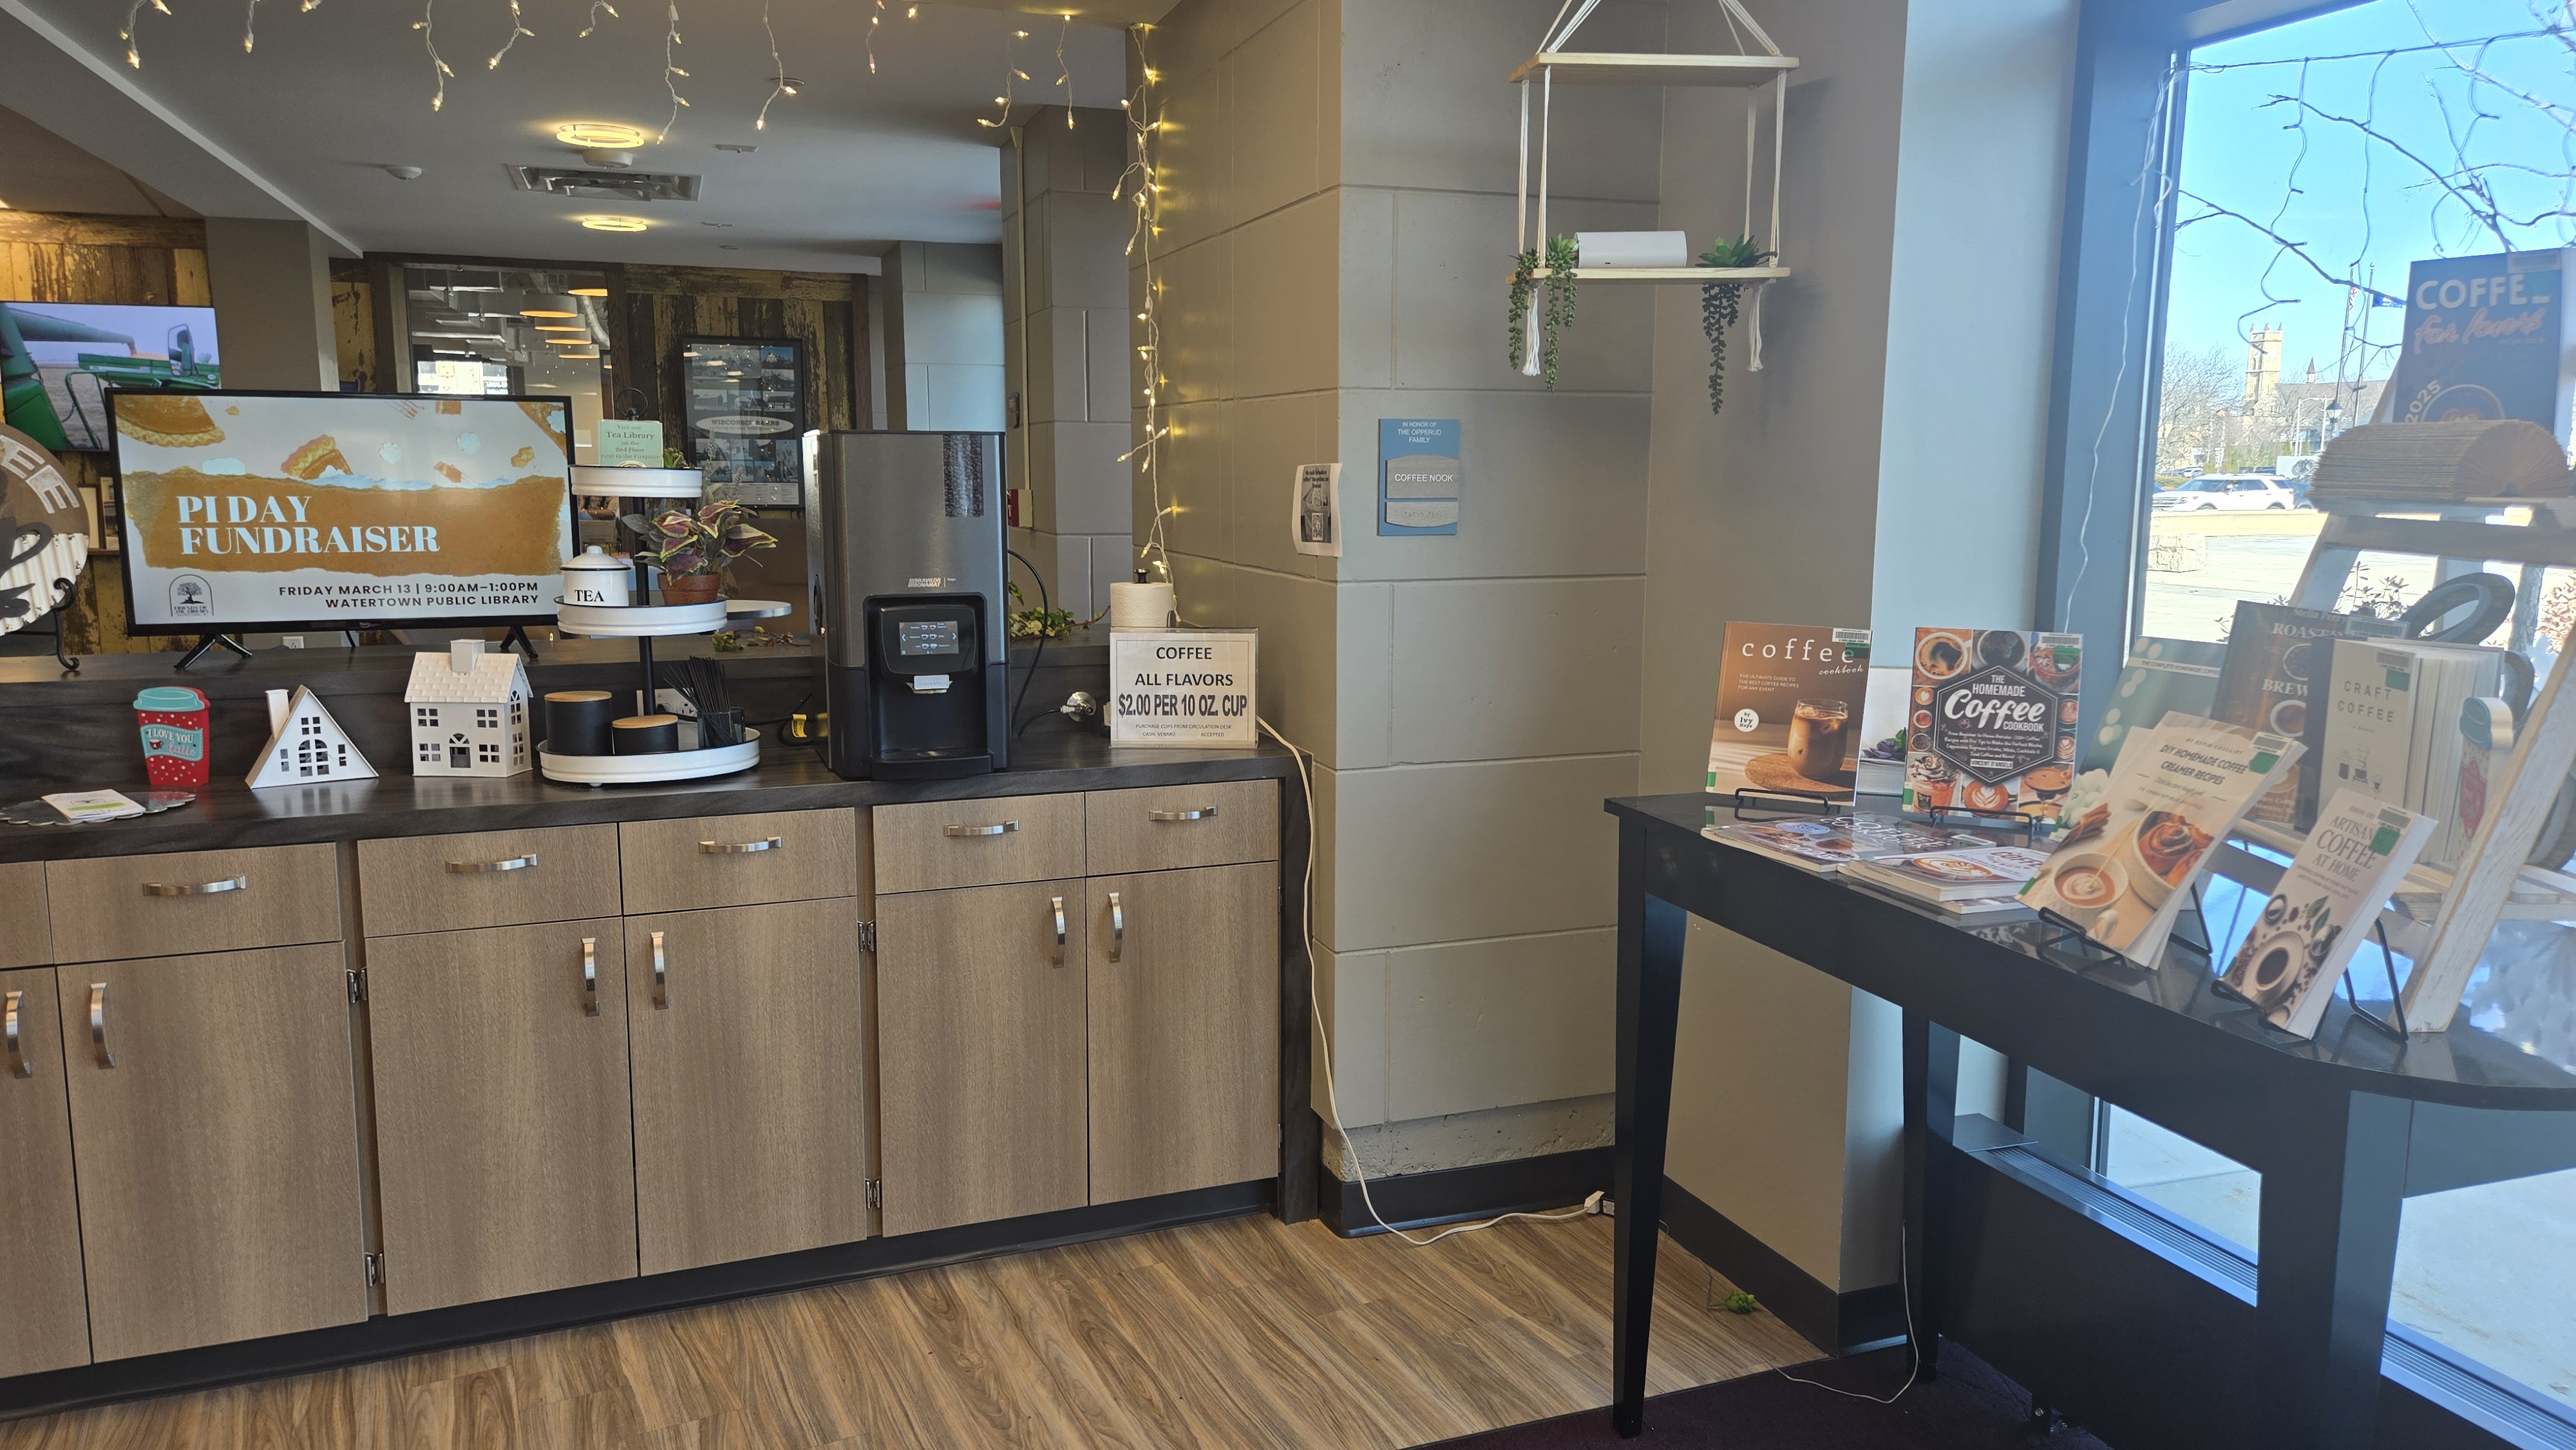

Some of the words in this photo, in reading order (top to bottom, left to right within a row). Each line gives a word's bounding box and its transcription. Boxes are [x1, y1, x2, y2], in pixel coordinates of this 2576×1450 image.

[2416, 274, 2550, 310] COFFE
[2404, 380, 2441, 423] 2025
[624, 432, 655, 440] Library
[1394, 474, 1428, 482] COFFEE
[1429, 474, 1454, 482] NOOK
[176, 496, 217, 523] PI
[227, 496, 312, 523] DAY
[180, 526, 440, 554] FUNDRAISER
[279, 586, 333, 596] FRIDAY
[339, 584, 392, 595] MARCH
[397, 584, 411, 594] 13
[574, 589, 605, 602] TEA
[325, 597, 422, 608] WATERTOWN
[427, 596, 477, 606] PUBLIC
[481, 595, 539, 605] LIBRARY
[1156, 647, 1212, 659] COFFEE
[1742, 638, 1854, 663] coffee
[1135, 673, 1161, 686] ALL
[1166, 673, 1233, 686] FLAVORS
[1819, 664, 1864, 675] cookbook
[1991, 675, 2005, 683] THE
[1973, 683, 2026, 697] HOMEMADE
[2344, 680, 2391, 700] CRAFT
[1119, 693, 1150, 718] $2.00
[1154, 694, 1178, 716] PER
[1181, 694, 1195, 716] 10
[1198, 694, 1218, 716] OZ.
[1222, 694, 1247, 717] CUP
[1944, 689, 2045, 730] Coffee
[2337, 700, 2394, 722] COFFEE
[154, 728, 174, 741] LOVE
[176, 733, 194, 743] YOU
[2003, 721, 2045, 732] COOKBOOK
[168, 740, 197, 756] latte
[2159, 744, 2177, 754] DIY
[2174, 748, 2219, 766] HOMEMADE
[2217, 760, 2248, 774] COFFEE
[2161, 761, 2195, 777] CREAMER
[2193, 770, 2225, 785] RECIPES
[2329, 815, 2376, 840] ARTISAN
[2316, 829, 2376, 869] COFFEE
[2312, 853, 2331, 867] AT
[2327, 859, 2361, 882] HOME
